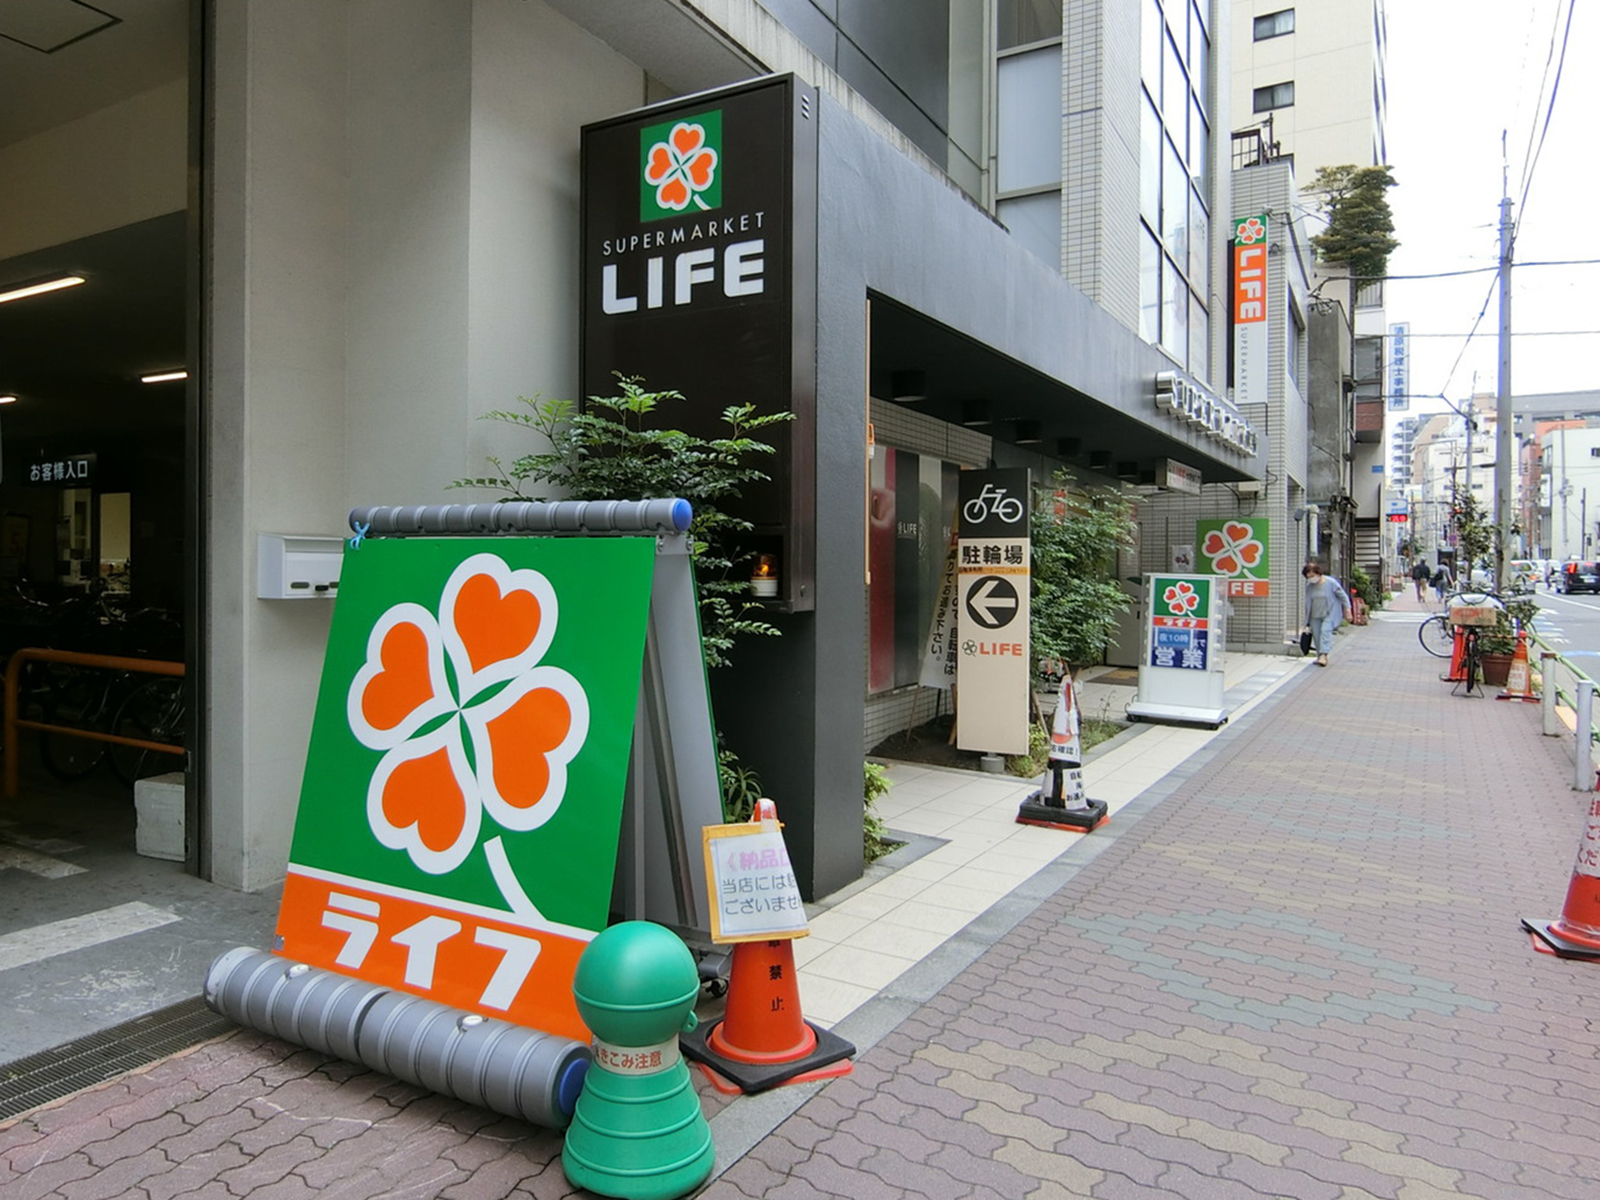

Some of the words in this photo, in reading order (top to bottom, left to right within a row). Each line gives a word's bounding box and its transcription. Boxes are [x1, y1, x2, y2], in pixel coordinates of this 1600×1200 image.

[603, 211, 765, 256] SUPERMARKET
[602, 239, 764, 315] LIFE
[1240, 249, 1262, 320] LIFE
[1240, 326, 1248, 400] SUPERMARKET
[29, 460, 89, 482] お客様入口
[962, 544, 1024, 565] 駐輪場
[1163, 618, 1198, 628] ライフ
[979, 642, 1023, 656] LIFE
[1155, 646, 1204, 669] 営業
[321, 891, 542, 1012] ライフ
